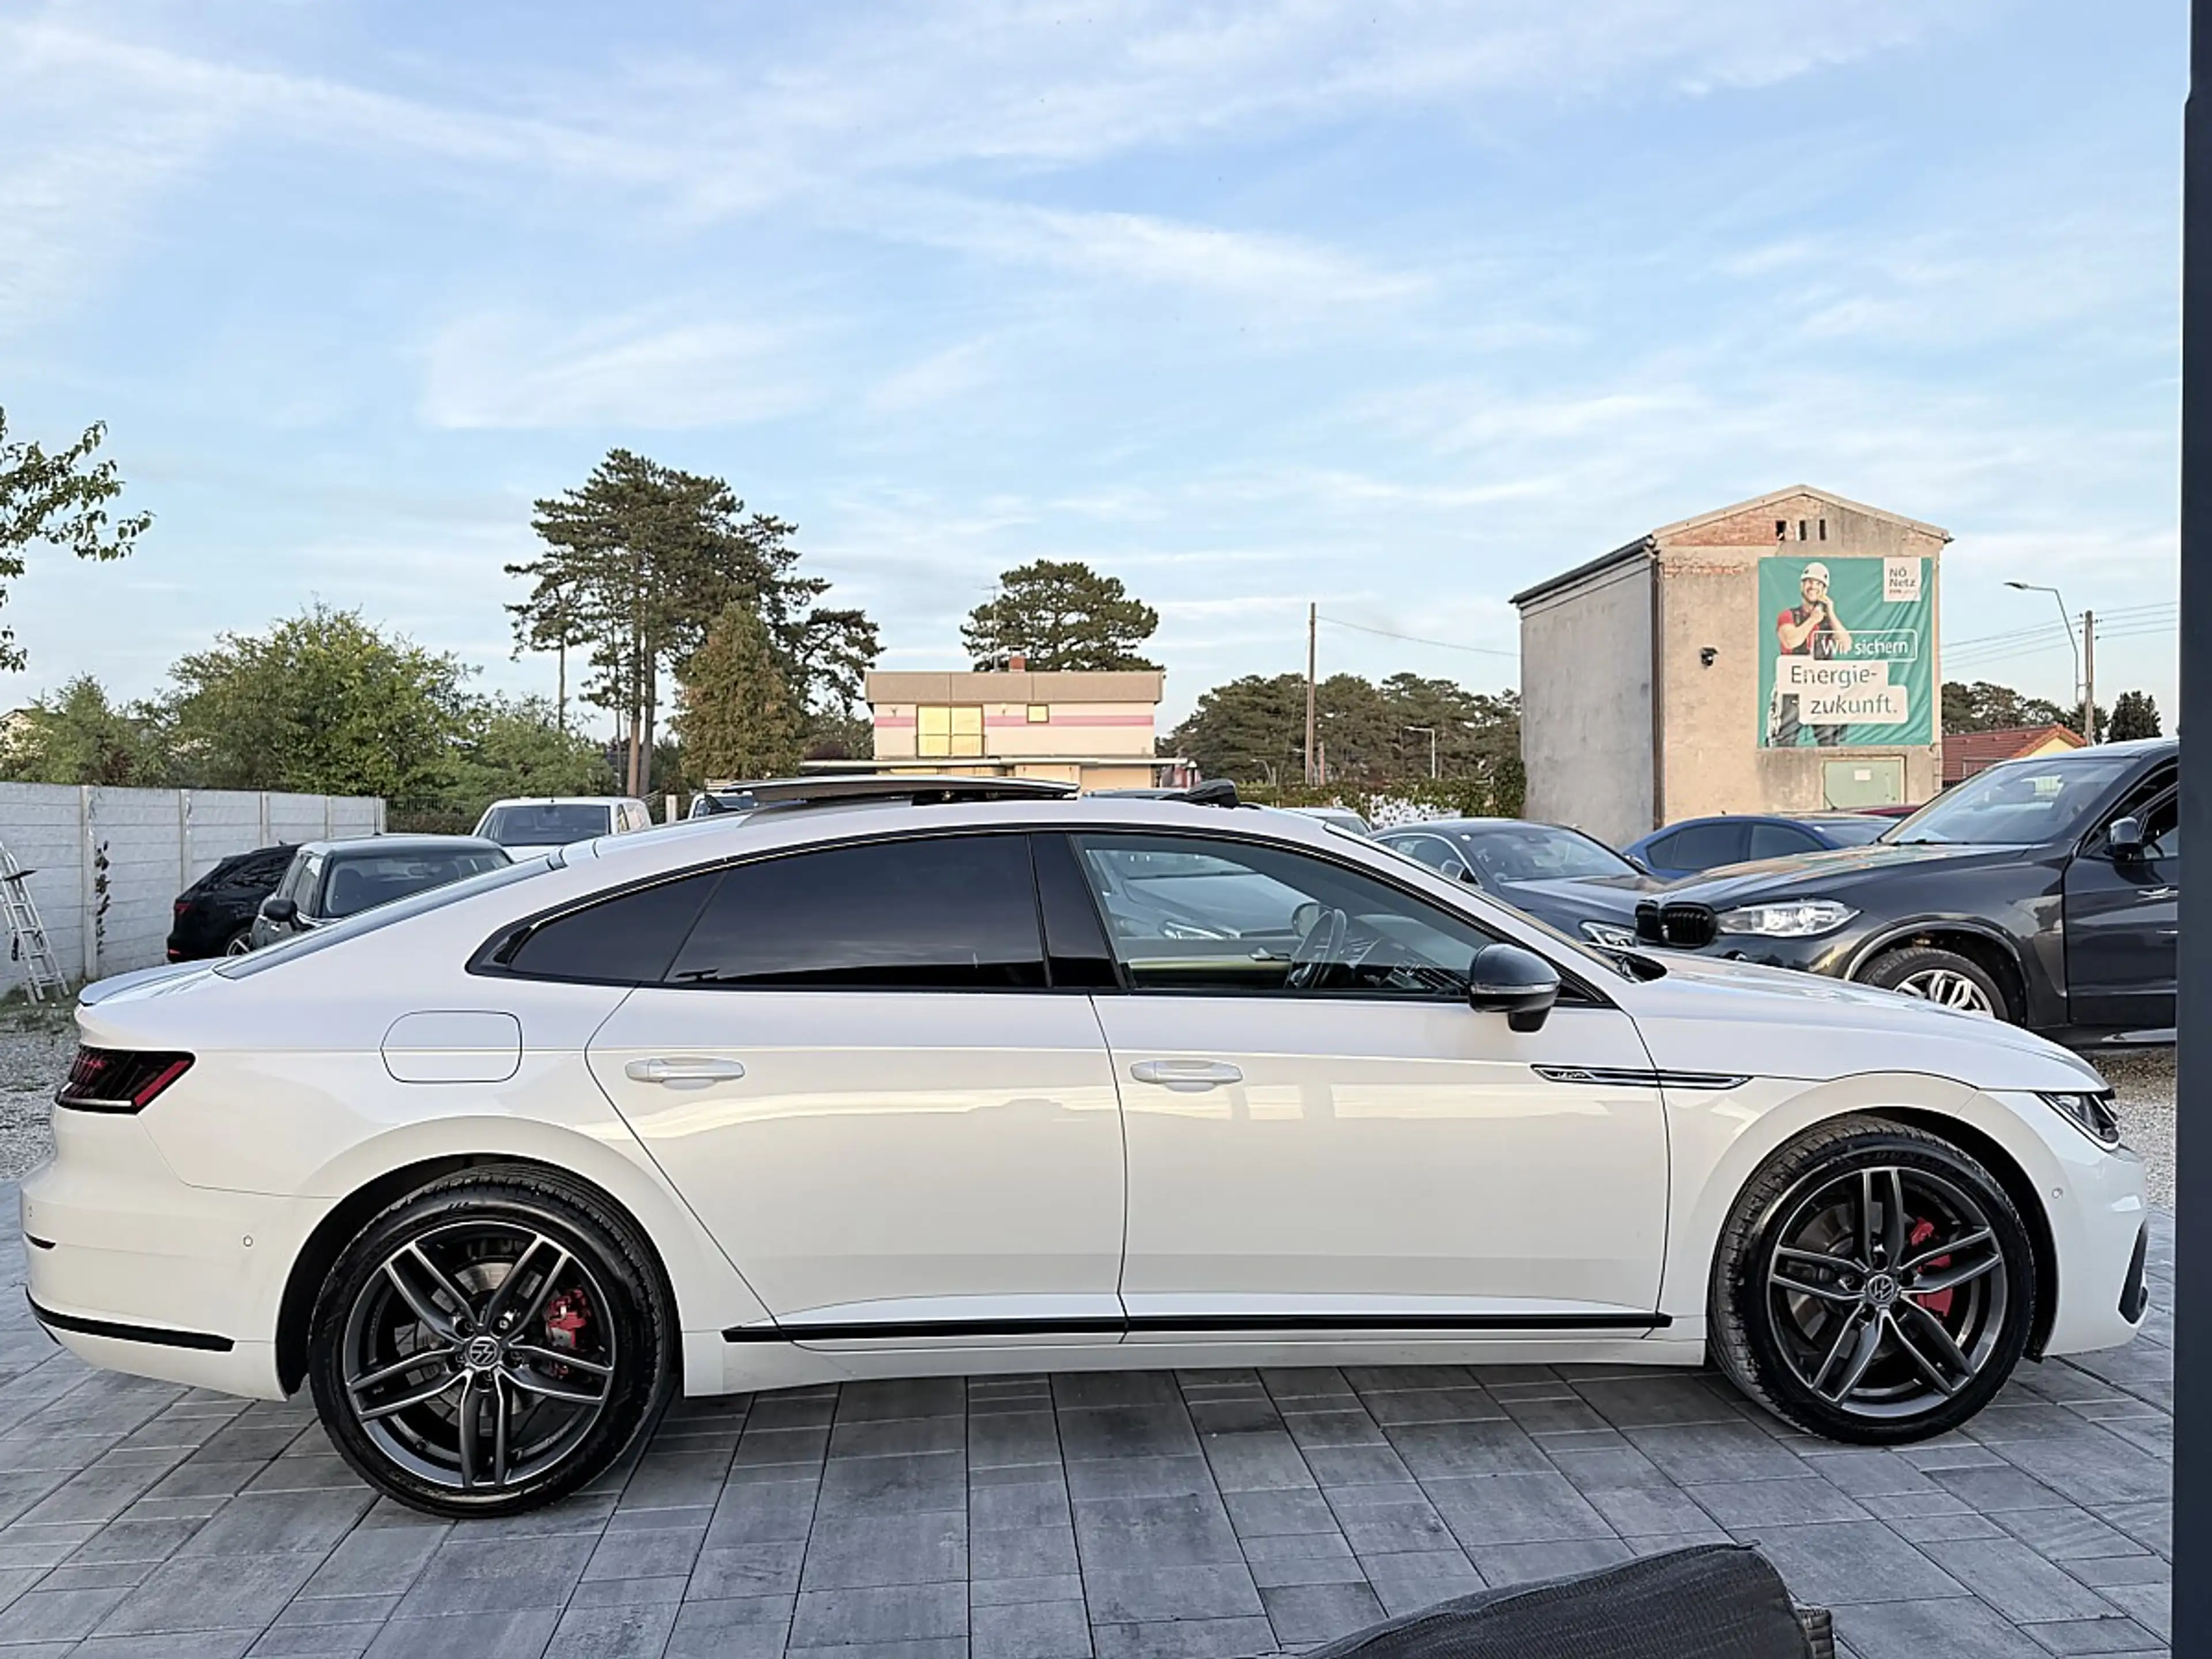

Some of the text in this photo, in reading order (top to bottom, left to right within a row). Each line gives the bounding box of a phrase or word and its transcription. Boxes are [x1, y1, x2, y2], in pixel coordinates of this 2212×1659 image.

[1889, 578, 1916, 586] Netz
[1854, 639, 1908, 655] sichern
[1791, 665, 1877, 688] Energie-
[1810, 694, 1897, 714] zukunft.
